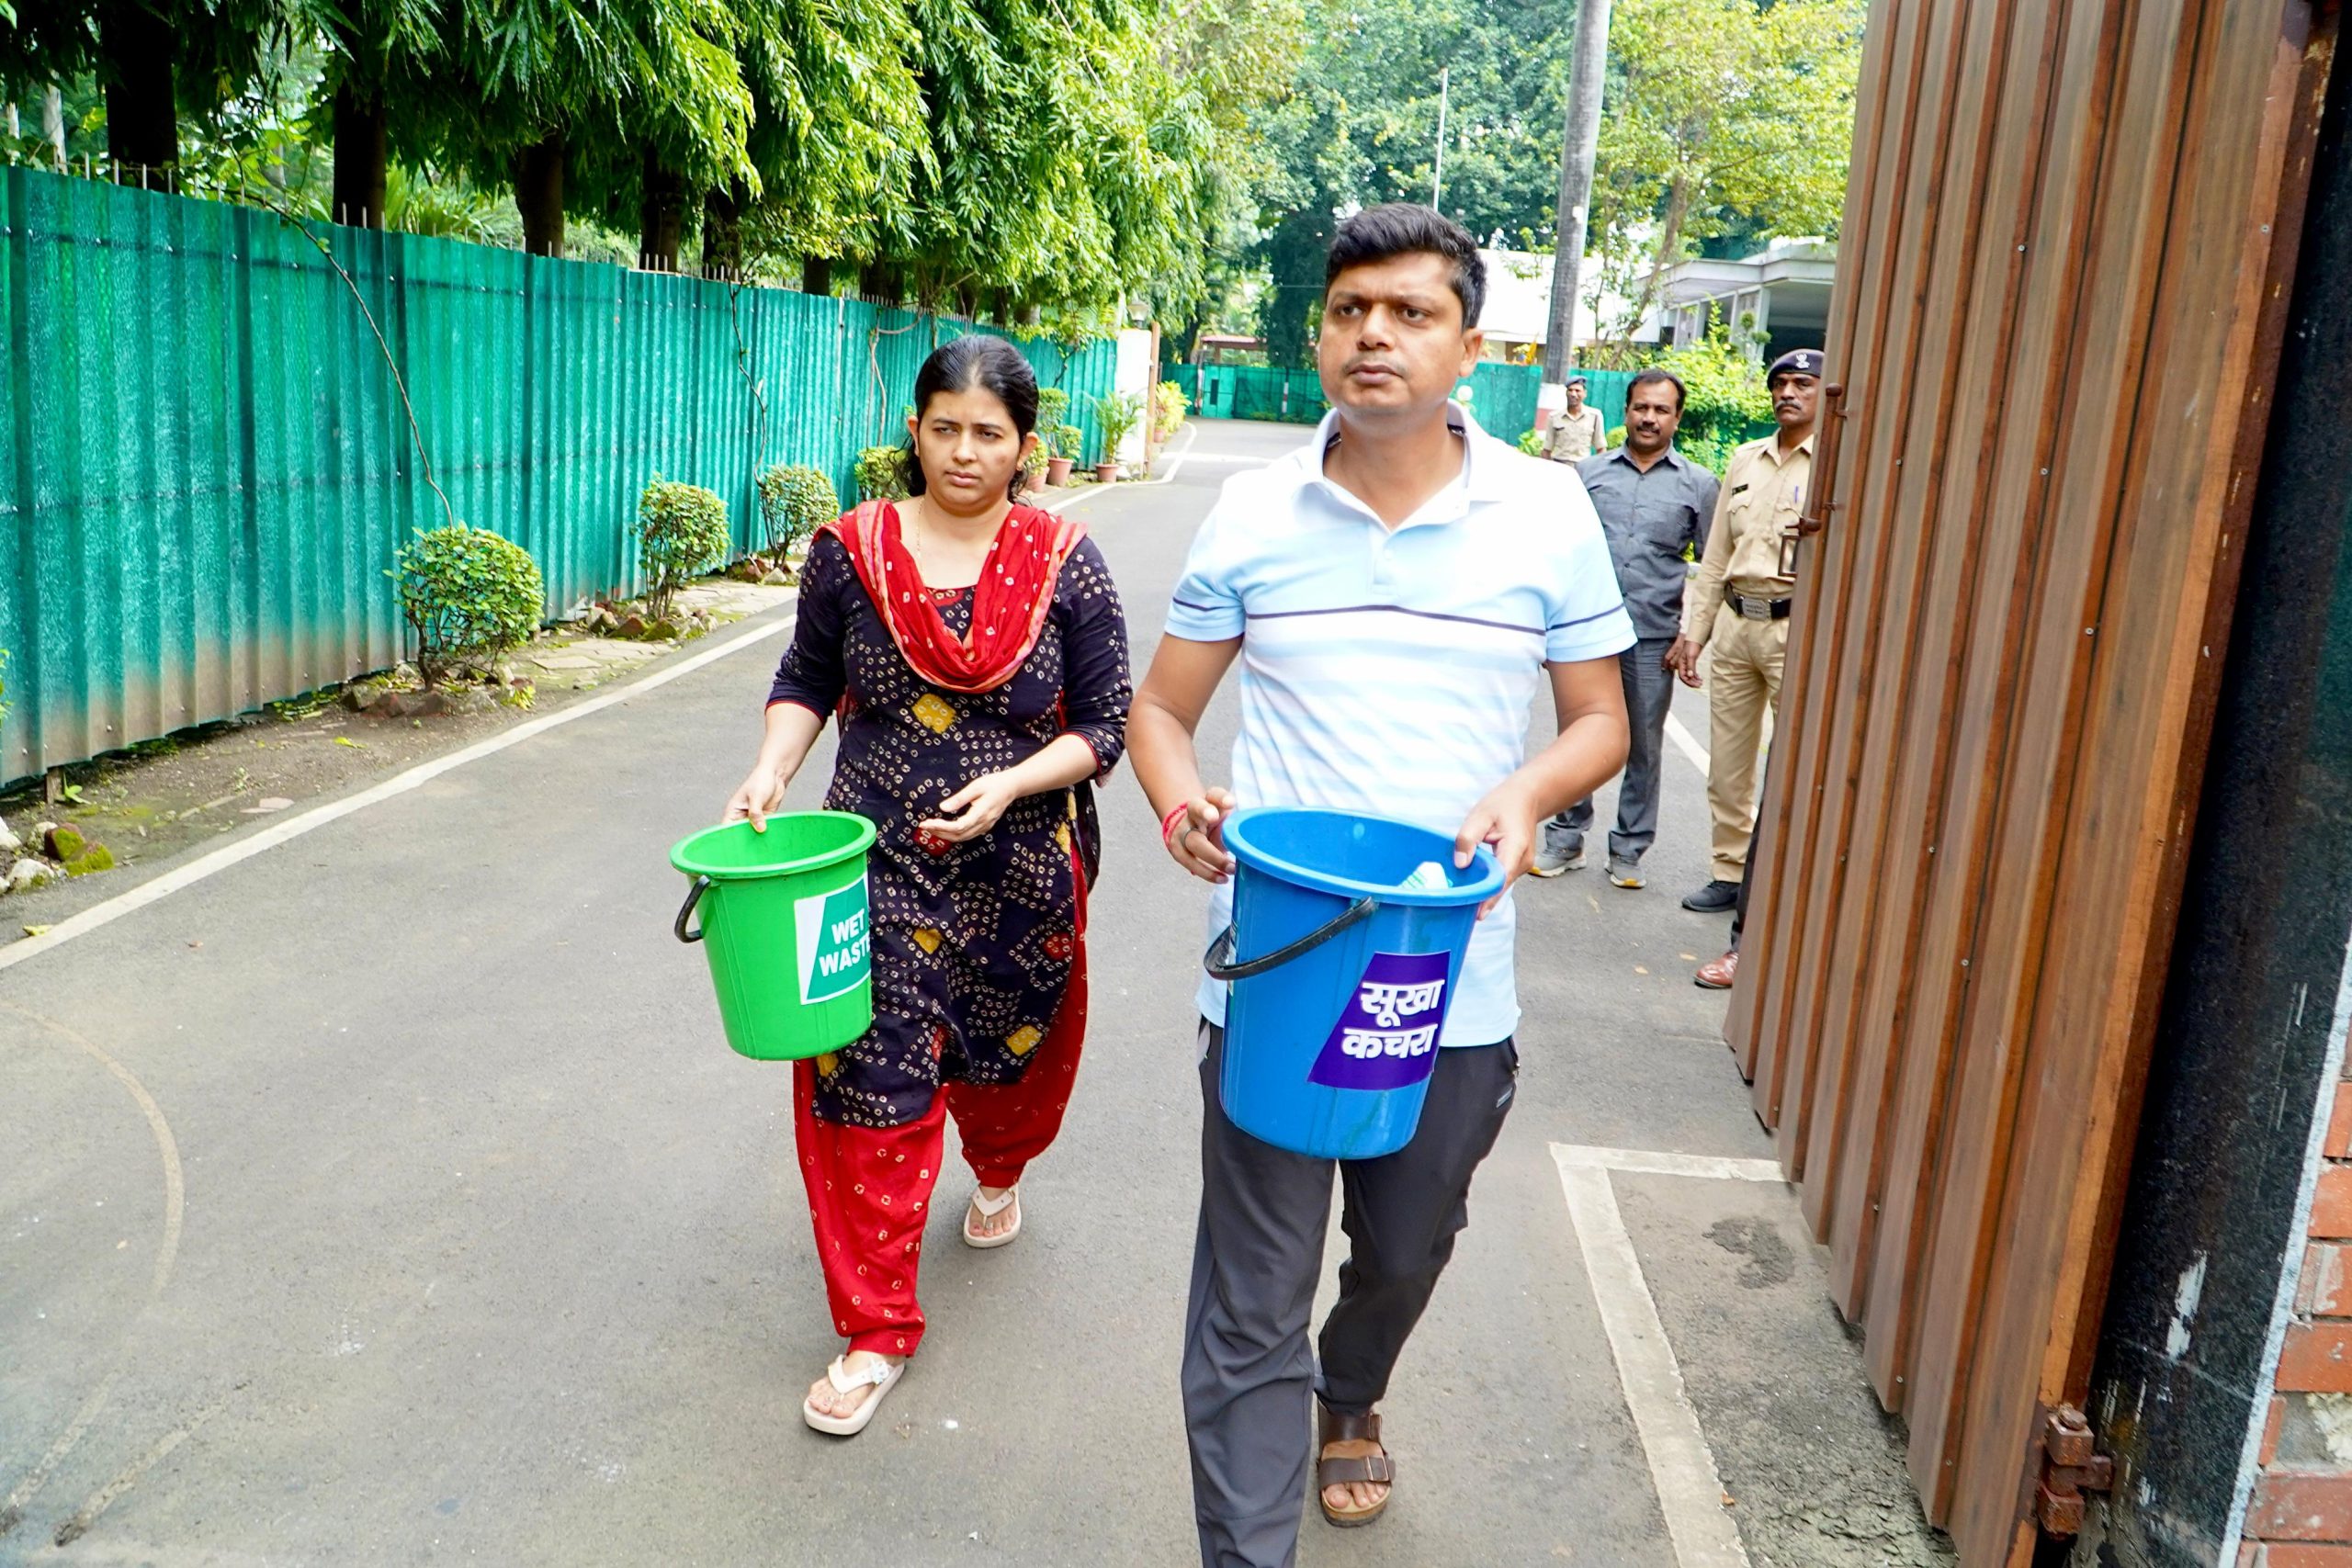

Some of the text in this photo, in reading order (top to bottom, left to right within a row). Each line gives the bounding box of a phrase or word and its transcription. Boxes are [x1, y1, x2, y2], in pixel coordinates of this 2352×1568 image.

[831, 908, 865, 945] WET
[1360, 979, 1445, 1028] सूखा
[1341, 1023, 1439, 1059] कचरा
